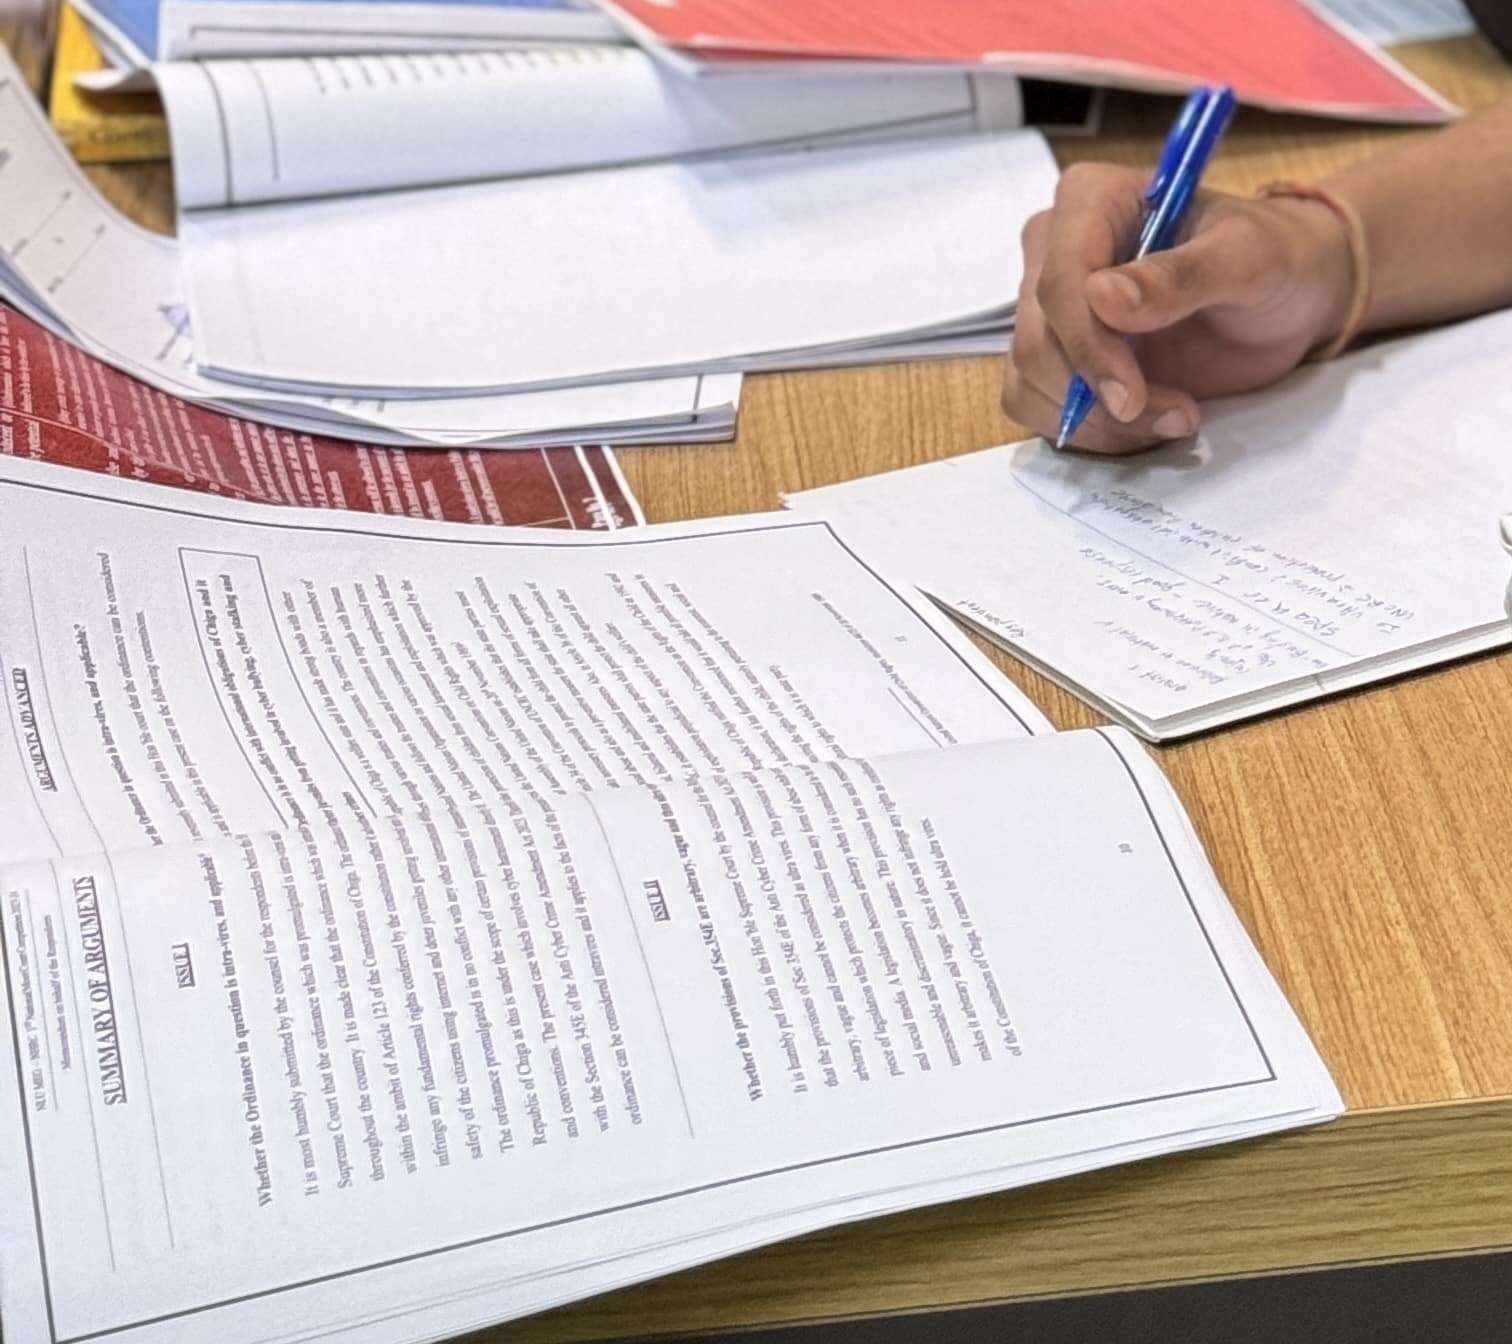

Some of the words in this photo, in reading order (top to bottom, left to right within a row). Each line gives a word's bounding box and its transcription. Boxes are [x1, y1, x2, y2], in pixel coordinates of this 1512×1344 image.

[194, 578, 209, 588] it
[217, 573, 234, 593] and
[105, 603, 120, 616] be
[195, 588, 212, 608] and
[11, 667, 39, 730] ADVANCED
[84, 680, 101, 699] and
[23, 728, 59, 793] ARGUMENTS
[526, 849, 552, 899] Amendment
[642, 879, 661, 890] II
[207, 898, 226, 918] and
[348, 895, 365, 910] of
[543, 900, 561, 929] Crime
[645, 888, 672, 923] ISSUE
[696, 904, 711, 921] are
[72, 875, 110, 975] ARGUMENTS
[258, 922, 275, 940] the
[171, 941, 190, 950] I
[261, 939, 278, 955] for
[354, 909, 378, 968] Constitution
[453, 925, 474, 962] conflict
[516, 930, 536, 960] which
[549, 930, 570, 959] Cyber
[297, 942, 311, 963] was
[490, 949, 507, 966] the
[172, 948, 196, 989] ISSUE
[263, 955, 286, 995] counsel
[365, 968, 382, 986] the
[391, 943, 415, 991] conferred
[463, 962, 478, 977] no
[527, 960, 543, 982] case
[555, 959, 575, 981] Anti
[711, 964, 729, 977] of
[87, 973, 114, 1003] OF
[223, 977, 239, 989] is
[298, 963, 317, 996] which
[464, 976, 480, 989] in
[495, 966, 514, 996] under
[563, 983, 579, 1000] the
[793, 983, 811, 996] of
[367, 986, 385, 999] of
[467, 989, 483, 1000] is
[501, 995, 517, 1007] is
[531, 982, 557, 1020] present
[592, 977, 620, 1032] considered
[720, 977, 747, 1031] provisions
[763, 987, 785, 1012] forth
[227, 989, 251, 1039] question
[272, 996, 289, 1015] the
[370, 999, 390, 1020] 123
[403, 991, 424, 1022] rights
[504, 1006, 521, 1028] this
[565, 998, 583, 1012] of
[861, 984, 889, 1037] legislation
[275, 1015, 295, 1033] by
[308, 996, 329, 1050] ordinance
[441, 1010, 459, 1041] using
[541, 1021, 558, 1045] The
[569, 1013, 591, 1042] 345E
[773, 1012, 794, 1030] put
[801, 996, 832, 1048] provisions
[375, 1022, 397, 1060] Article
[468, 1000, 502, 1069] promulgated
[511, 1028, 525, 1041] as
[608, 1033, 625, 1048] be
[735, 1031, 750, 1050] the
[873, 1034, 892, 1049] of
[91, 1002, 128, 1106] SUMMARY
[234, 1040, 250, 1055] in
[407, 1023, 437, 1093] fundamental
[514, 1041, 533, 1076] Chiga
[614, 1047, 629, 1069] can
[778, 1030, 803, 1072] humbly
[817, 1048, 833, 1066] the
[277, 1031, 303, 1089] submitted
[315, 1051, 332, 1071] the
[381, 1062, 400, 1076] of
[449, 1041, 468, 1085] citizens
[580, 1042, 601, 1085] Section
[882, 1049, 905, 1078] piece
[319, 1071, 336, 1096] that
[517, 1076, 536, 1091] of
[548, 1044, 574, 1115] conventions.
[741, 1050, 764, 1103] Whether
[789, 1071, 806, 1083] is
[793, 1083, 809, 1094] It
[821, 1066, 840, 1088] that
[239, 1055, 261, 1123] Ordinance
[387, 1076, 407, 1112] ambit
[455, 1086, 472, 1106] the
[487, 1069, 510, 1127] ordinance
[588, 1084, 605, 1104] the
[619, 1069, 643, 1126] ordinance
[288, 1090, 311, 1138] humbly
[324, 1095, 343, 1133] Court
[356, 1093, 373, 1113] the
[426, 1094, 443, 1117] any
[457, 1107, 476, 1121] of
[394, 1113, 411, 1134] the
[523, 1092, 548, 1148] Republic
[559, 1115, 580, 1139] and
[591, 1104, 611, 1134] with
[248, 1124, 265, 1146] the
[431, 1118, 451, 1168] infringe
[464, 1123, 484, 1161] safety
[498, 1127, 515, 1155] The
[298, 1137, 316, 1170] most
[359, 1114, 385, 1182] throughout
[398, 1134, 418, 1176] within
[332, 1133, 355, 1190] Supreme
[253, 1147, 273, 1208] Whether
[303, 1170, 318, 1183] is
[303, 1184, 321, 1197] It
